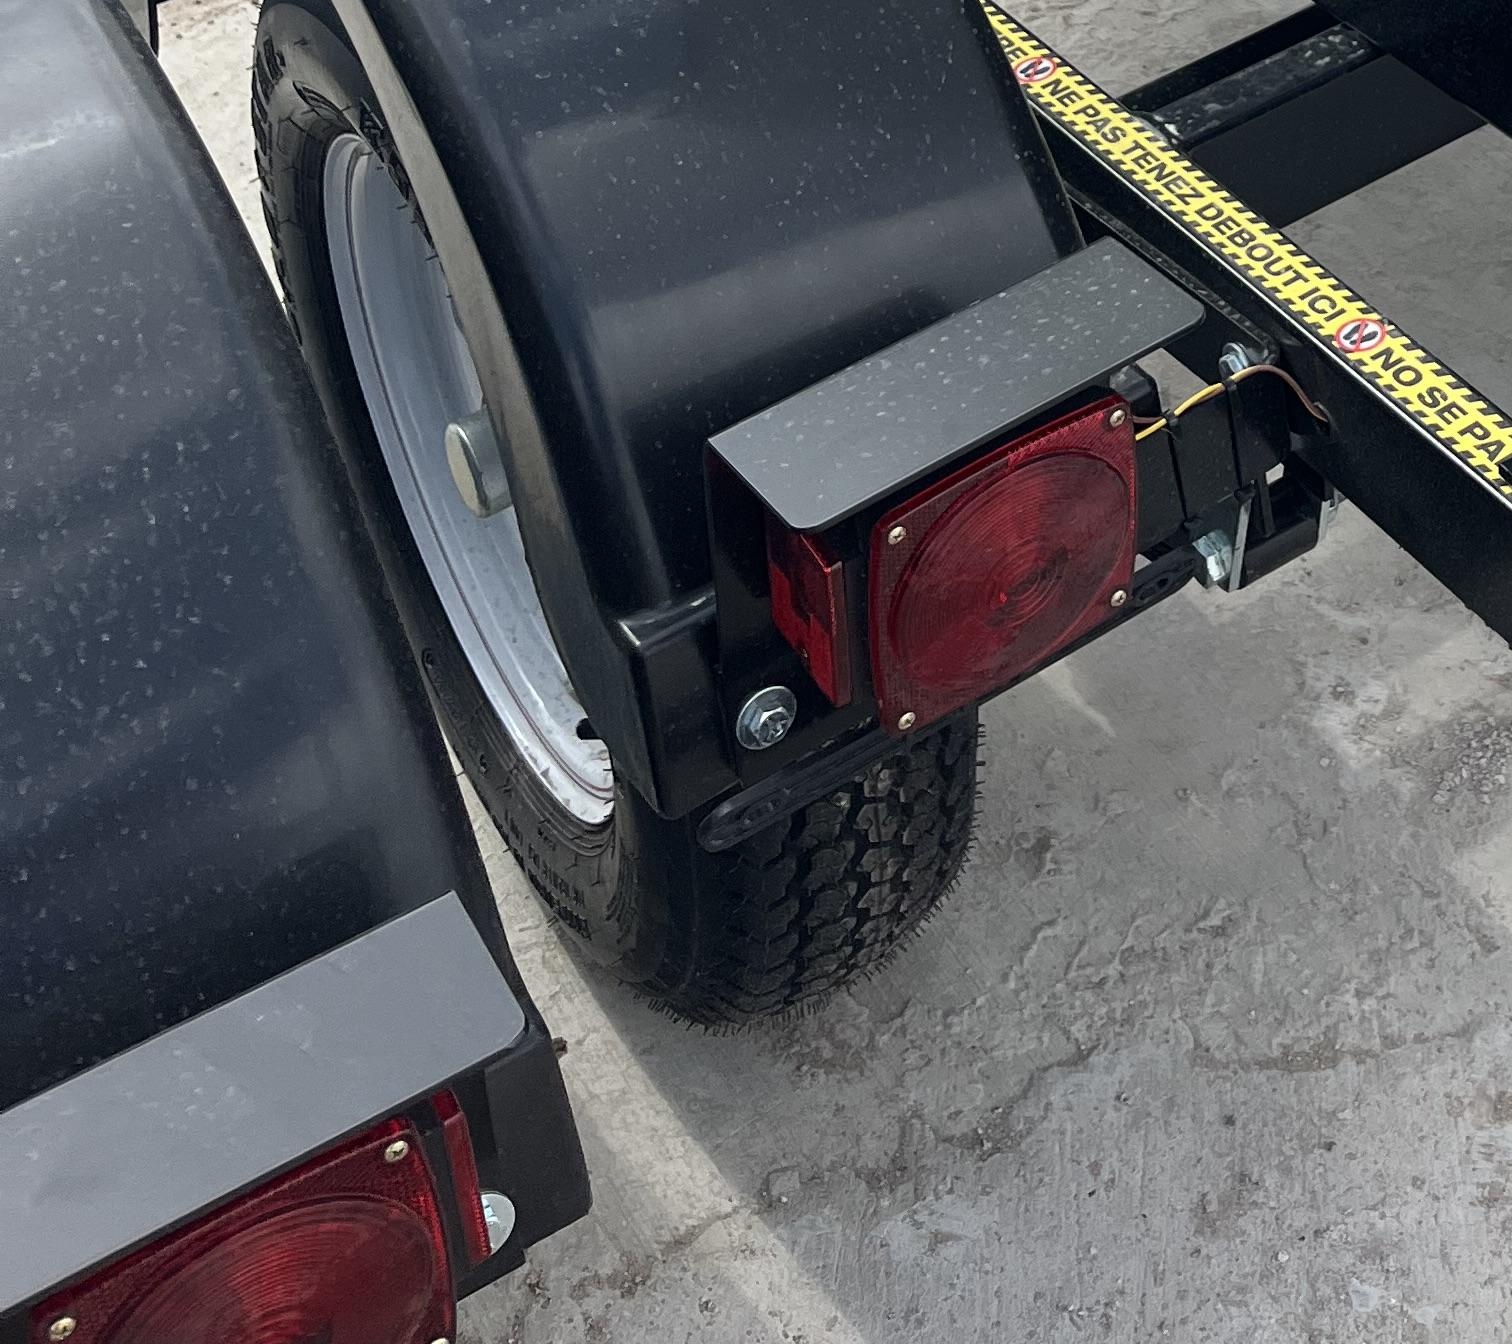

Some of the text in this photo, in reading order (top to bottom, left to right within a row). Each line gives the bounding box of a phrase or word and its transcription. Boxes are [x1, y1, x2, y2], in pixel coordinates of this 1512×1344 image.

[1041, 76, 1348, 322] NE PAS TENEZ DEBOUT ICI
[1370, 346, 1424, 387] NO
[1416, 385, 1469, 425] SE
